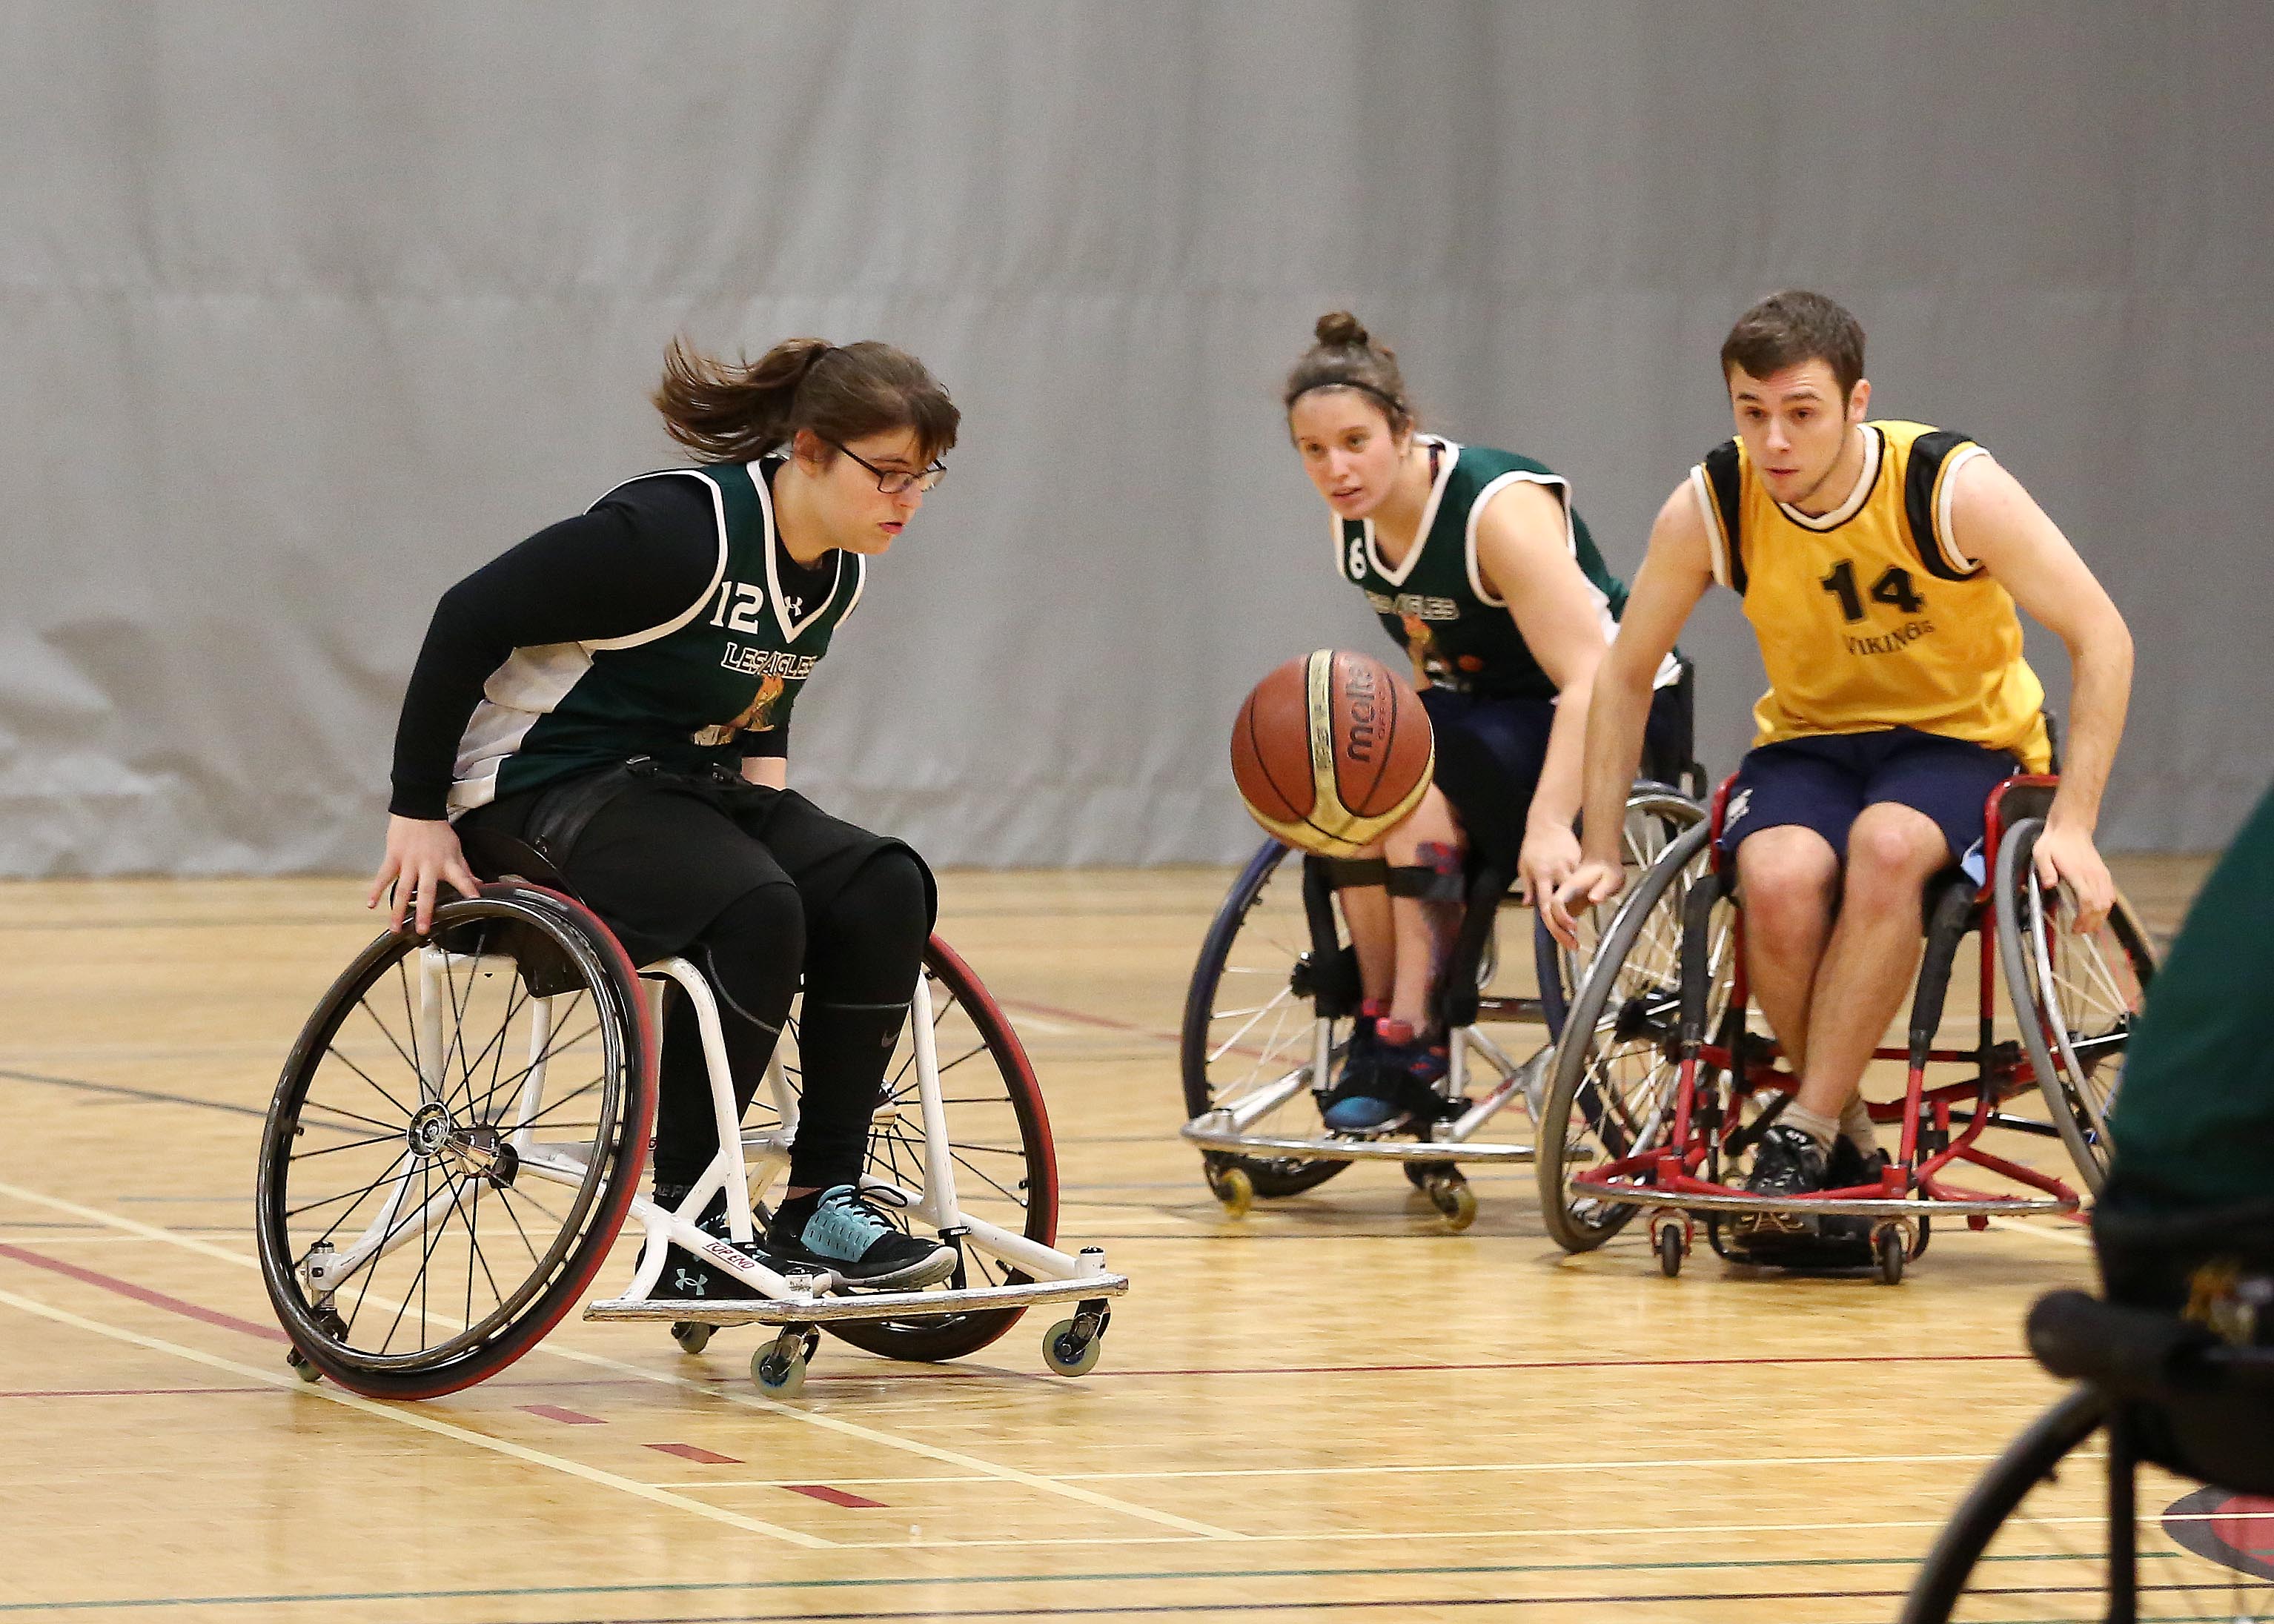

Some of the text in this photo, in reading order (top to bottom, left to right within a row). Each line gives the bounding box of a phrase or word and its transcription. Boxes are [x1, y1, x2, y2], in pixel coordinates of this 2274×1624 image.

[1349, 537, 1367, 580] 6
[709, 580, 764, 635] 12
[1821, 559, 1925, 621] 14
[1843, 620, 1935, 655] VIKINGS
[720, 642, 769, 675] LES
[706, 1242, 755, 1269] TOP END
